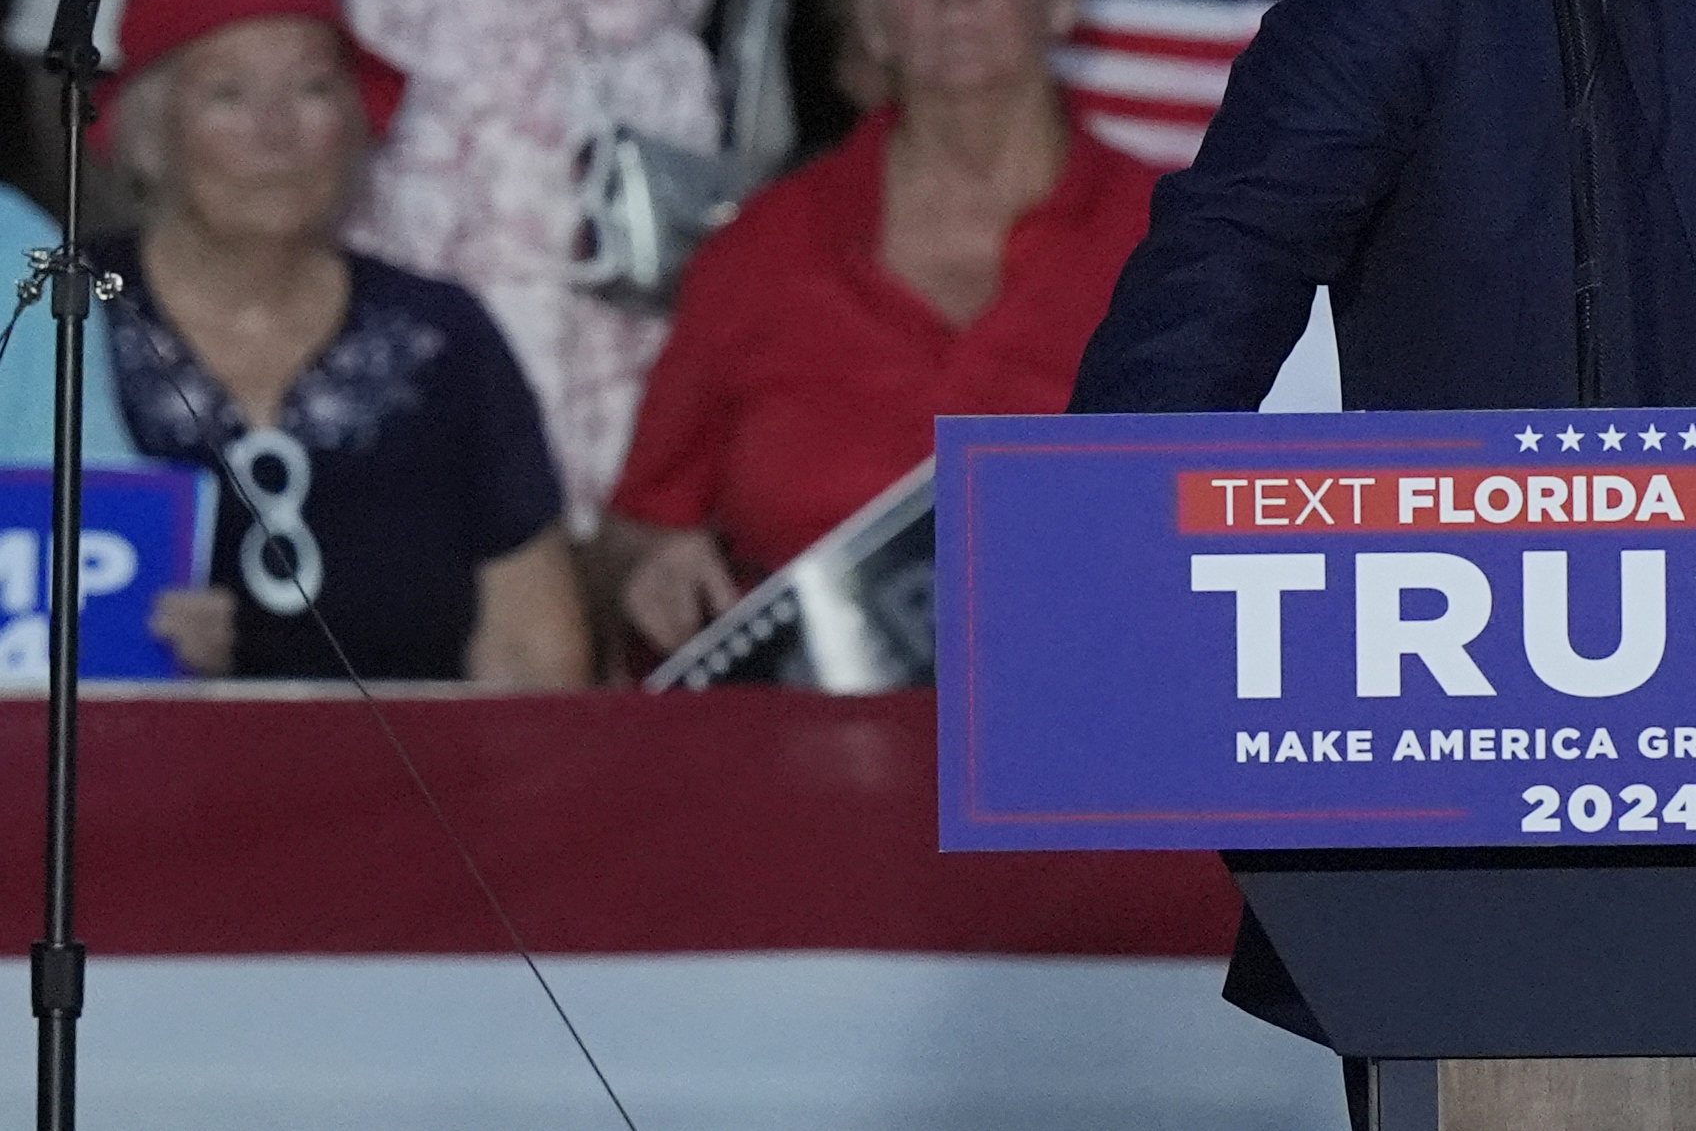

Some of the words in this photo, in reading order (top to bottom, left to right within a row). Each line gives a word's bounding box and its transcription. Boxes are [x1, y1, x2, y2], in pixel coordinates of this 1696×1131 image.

[1211, 478, 1375, 526] TEXT
[1398, 473, 1684, 524] FLORIDA
[1236, 730, 1373, 763] MAKE
[1392, 727, 1618, 761] AMERICA
